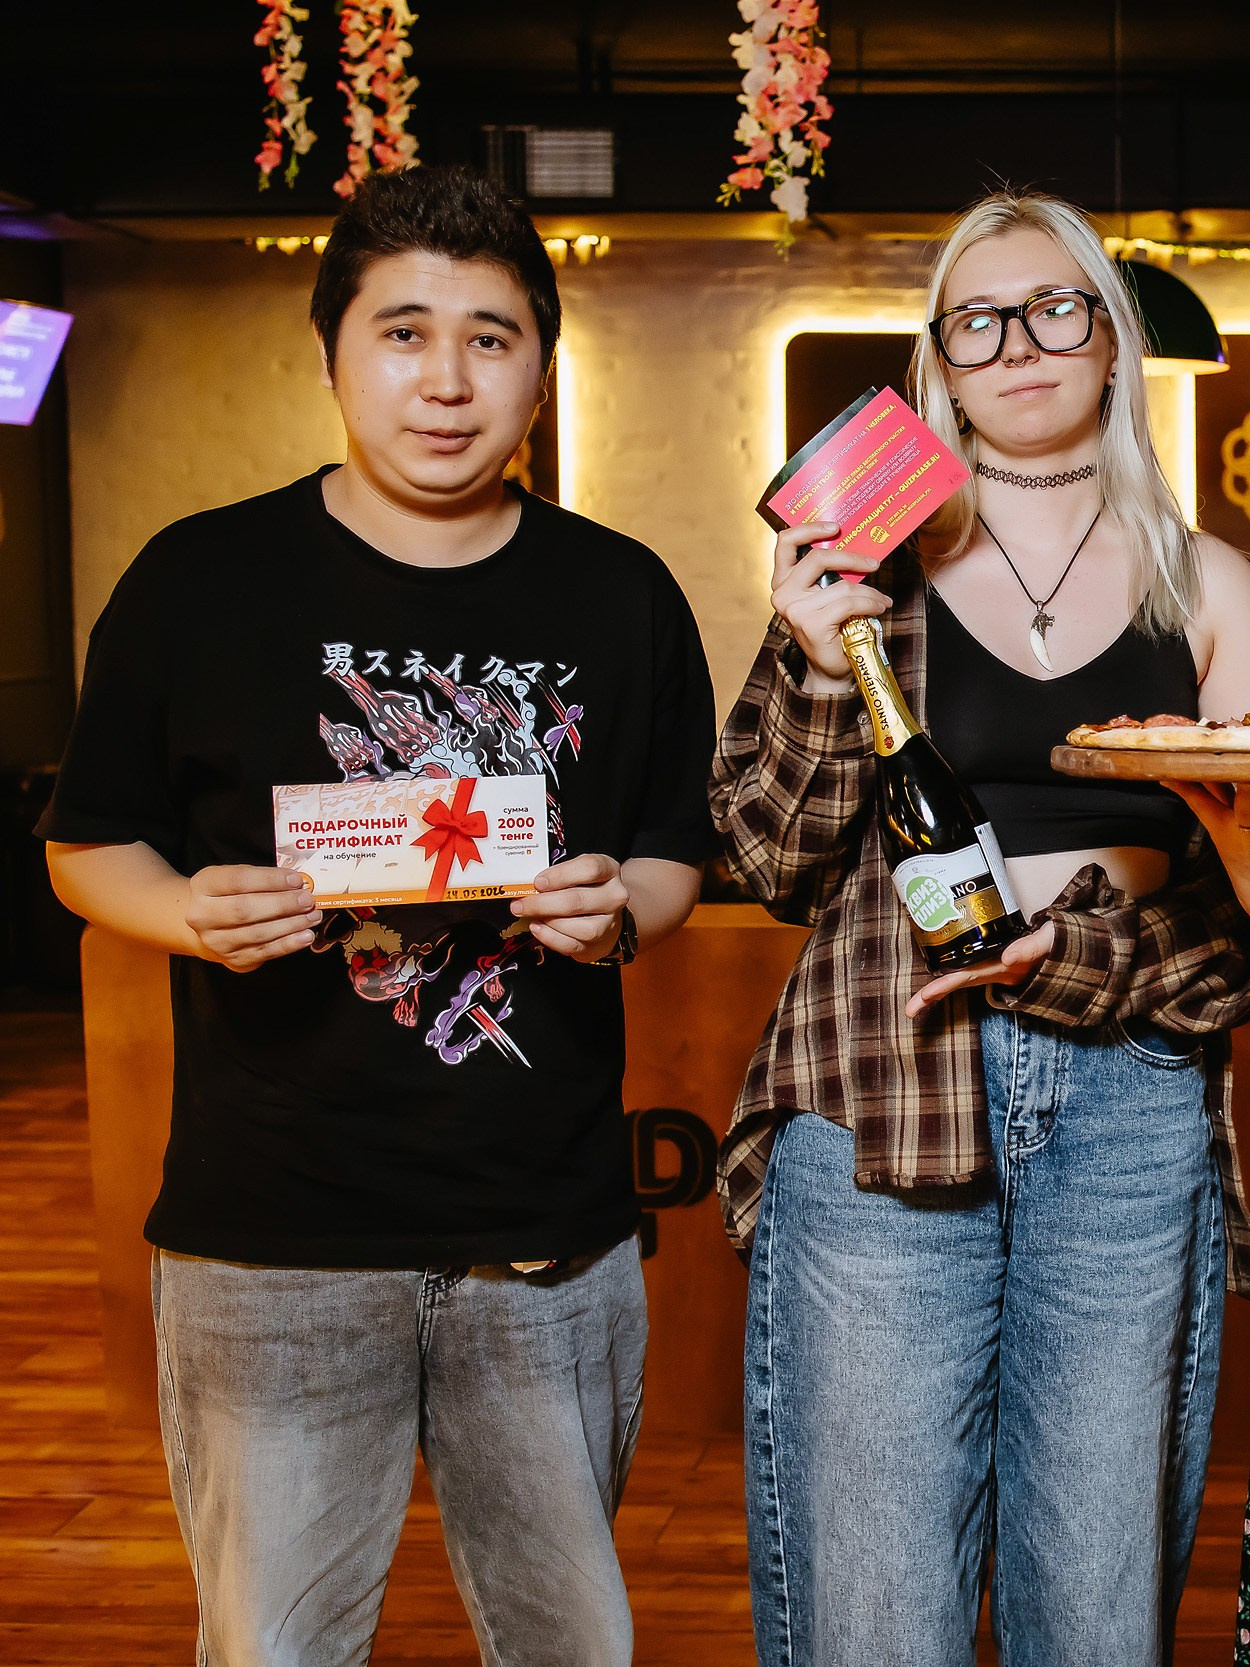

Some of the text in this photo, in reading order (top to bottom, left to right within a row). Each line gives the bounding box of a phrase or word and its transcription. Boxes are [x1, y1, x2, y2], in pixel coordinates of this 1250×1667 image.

[828, 436, 859, 466] СЕРТИФИКАТ
[793, 492, 813, 510] ТЕПЕРЬ
[810, 483, 820, 493] ОН
[818, 469, 835, 485] ТВОЙ!
[834, 541, 845, 552] СЯ
[843, 504, 885, 544] ИНФОРМАЦИЯ
[882, 494, 895, 506] ТУТ
[898, 452, 940, 492] QUIZPLEASE.RU
[856, 655, 889, 730] SANTO STEFANO
[503, 806, 529, 815] сумма
[288, 813, 408, 835] ПОДАРОЧНЫЙ
[497, 816, 535, 829] 2000
[295, 834, 403, 850] СЕРТИФИКАТ
[500, 832, 534, 841] тенге
[335, 852, 377, 861] обучение
